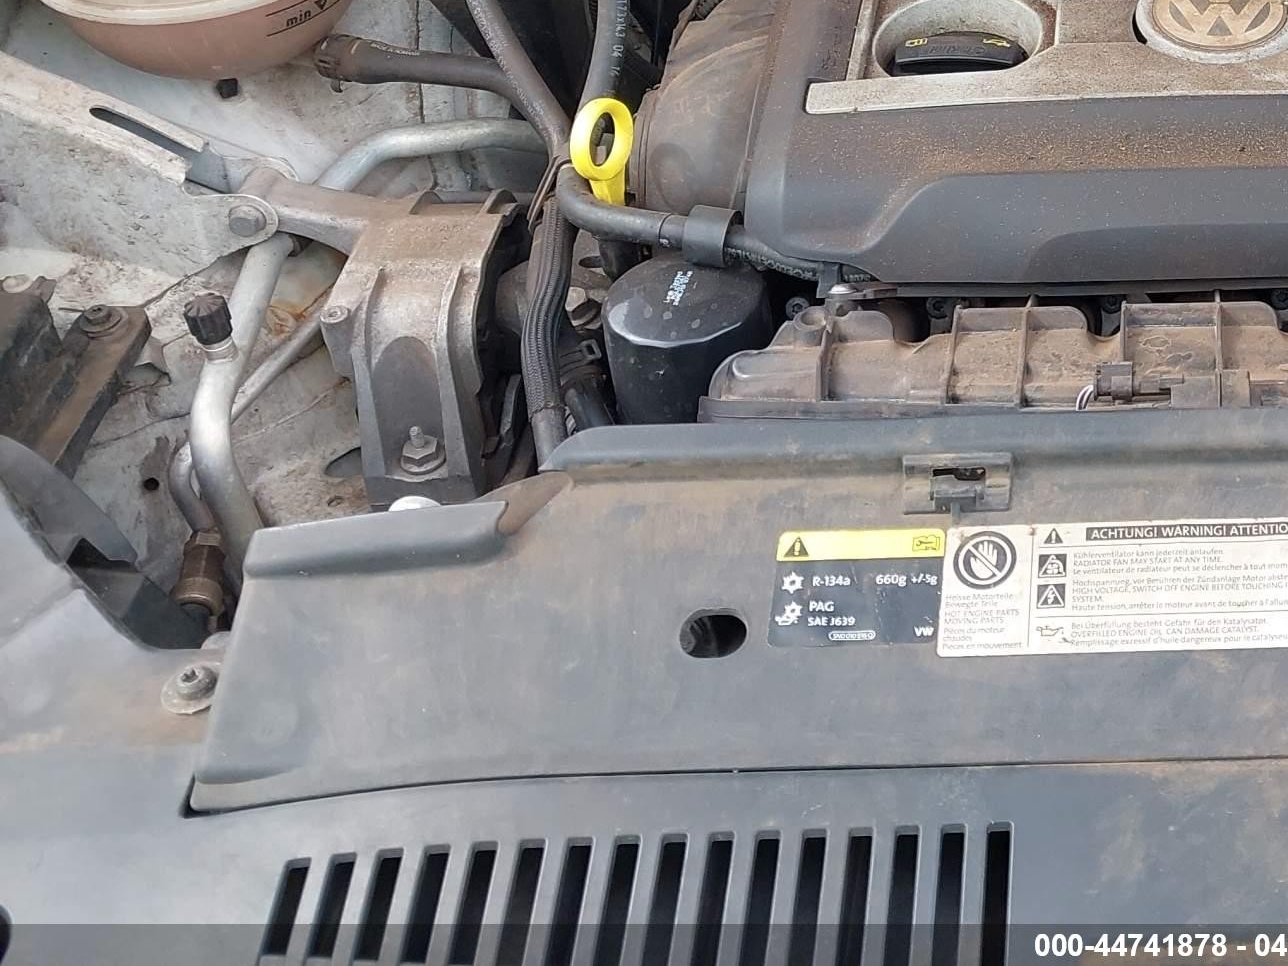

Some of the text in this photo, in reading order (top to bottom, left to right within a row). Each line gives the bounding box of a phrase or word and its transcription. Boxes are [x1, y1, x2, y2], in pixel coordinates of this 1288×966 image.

[286, 10, 311, 27] min
[1091, 527, 1157, 539] ACHTUNG!
[1161, 525, 1226, 538] WARNING!
[1174, 565, 1190, 574] peut
[812, 573, 938, 587] R-134a 660g +/-5g
[809, 601, 834, 612] PAG
[807, 616, 856, 626] SAE J639
[914, 626, 934, 636] VW
